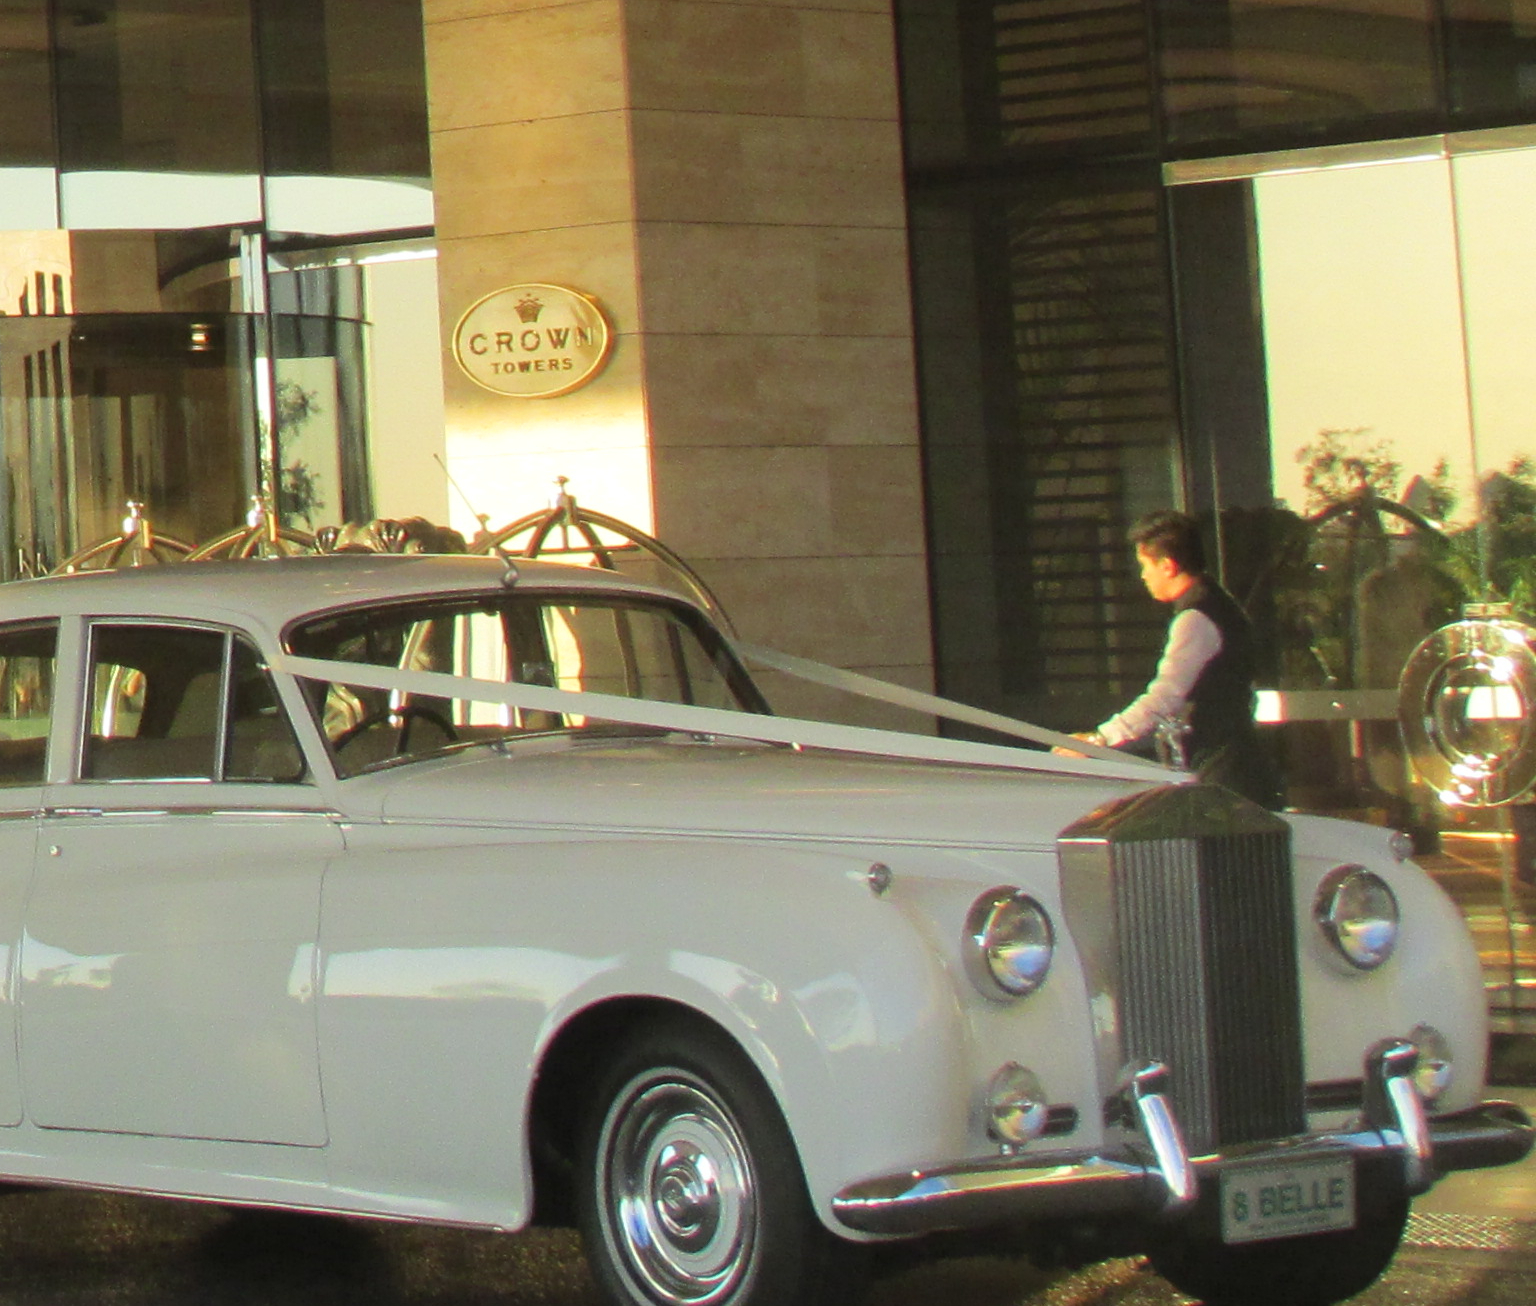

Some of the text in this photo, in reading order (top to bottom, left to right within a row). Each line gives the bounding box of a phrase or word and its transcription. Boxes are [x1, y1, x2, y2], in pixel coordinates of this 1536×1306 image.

[469, 326, 594, 355] CROWN
[491, 358, 573, 374] TOWERS
[1260, 1178, 1345, 1217] BELLE
